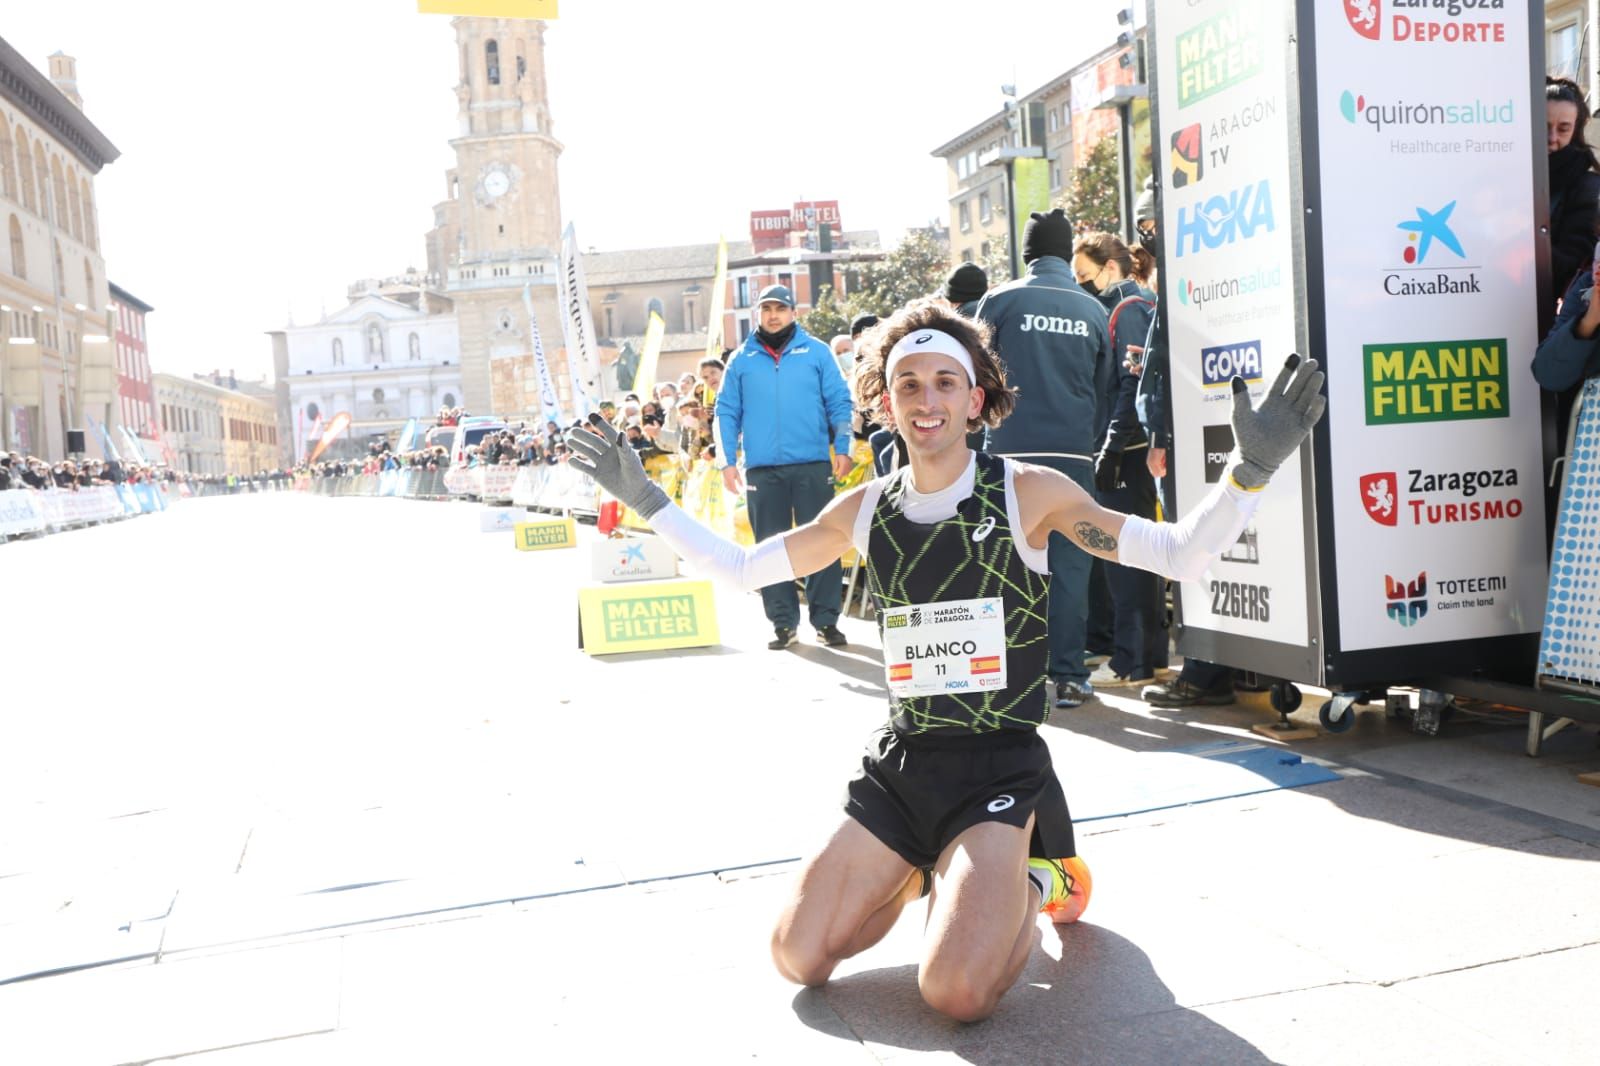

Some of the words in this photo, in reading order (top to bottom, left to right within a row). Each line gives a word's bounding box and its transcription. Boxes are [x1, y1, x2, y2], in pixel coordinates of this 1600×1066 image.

[1393, 15, 1504, 42] DEPORTE
[1182, 39, 1259, 100] FILTER
[1210, 96, 1276, 141] ARAGÓN
[1366, 100, 1514, 132] quirónsalud
[1210, 145, 1230, 168] TV
[1390, 139, 1461, 153] Healthcare
[1465, 138, 1515, 153] Partner
[753, 216, 790, 230] TIBUR
[795, 207, 840, 223] HTEL
[1176, 179, 1275, 258] HOKA
[1192, 264, 1281, 311] quirónsalud
[1384, 273, 1481, 295] CaixaBank
[1020, 314, 1089, 337] Joma
[1204, 346, 1259, 381] GOYA
[1371, 346, 1500, 382] MANN
[1373, 380, 1502, 417] FILTER
[1408, 468, 1518, 497] Zaragoza
[1408, 499, 1523, 525] TURISMO
[527, 525, 565, 536] MANN
[528, 534, 566, 545] FILTER
[1436, 576, 1507, 595] TOTEEMI
[607, 598, 690, 620] MANN
[934, 605, 970, 616] MARATÓN
[1211, 580, 1270, 622] 226ERS
[1437, 600, 1461, 610] Claim
[1462, 599, 1475, 608] the
[1476, 596, 1494, 606] land
[609, 616, 693, 639] FILTER
[934, 614, 975, 624] ZARAGOZA
[905, 640, 977, 660] BLANCO
[935, 664, 947, 676] 11
